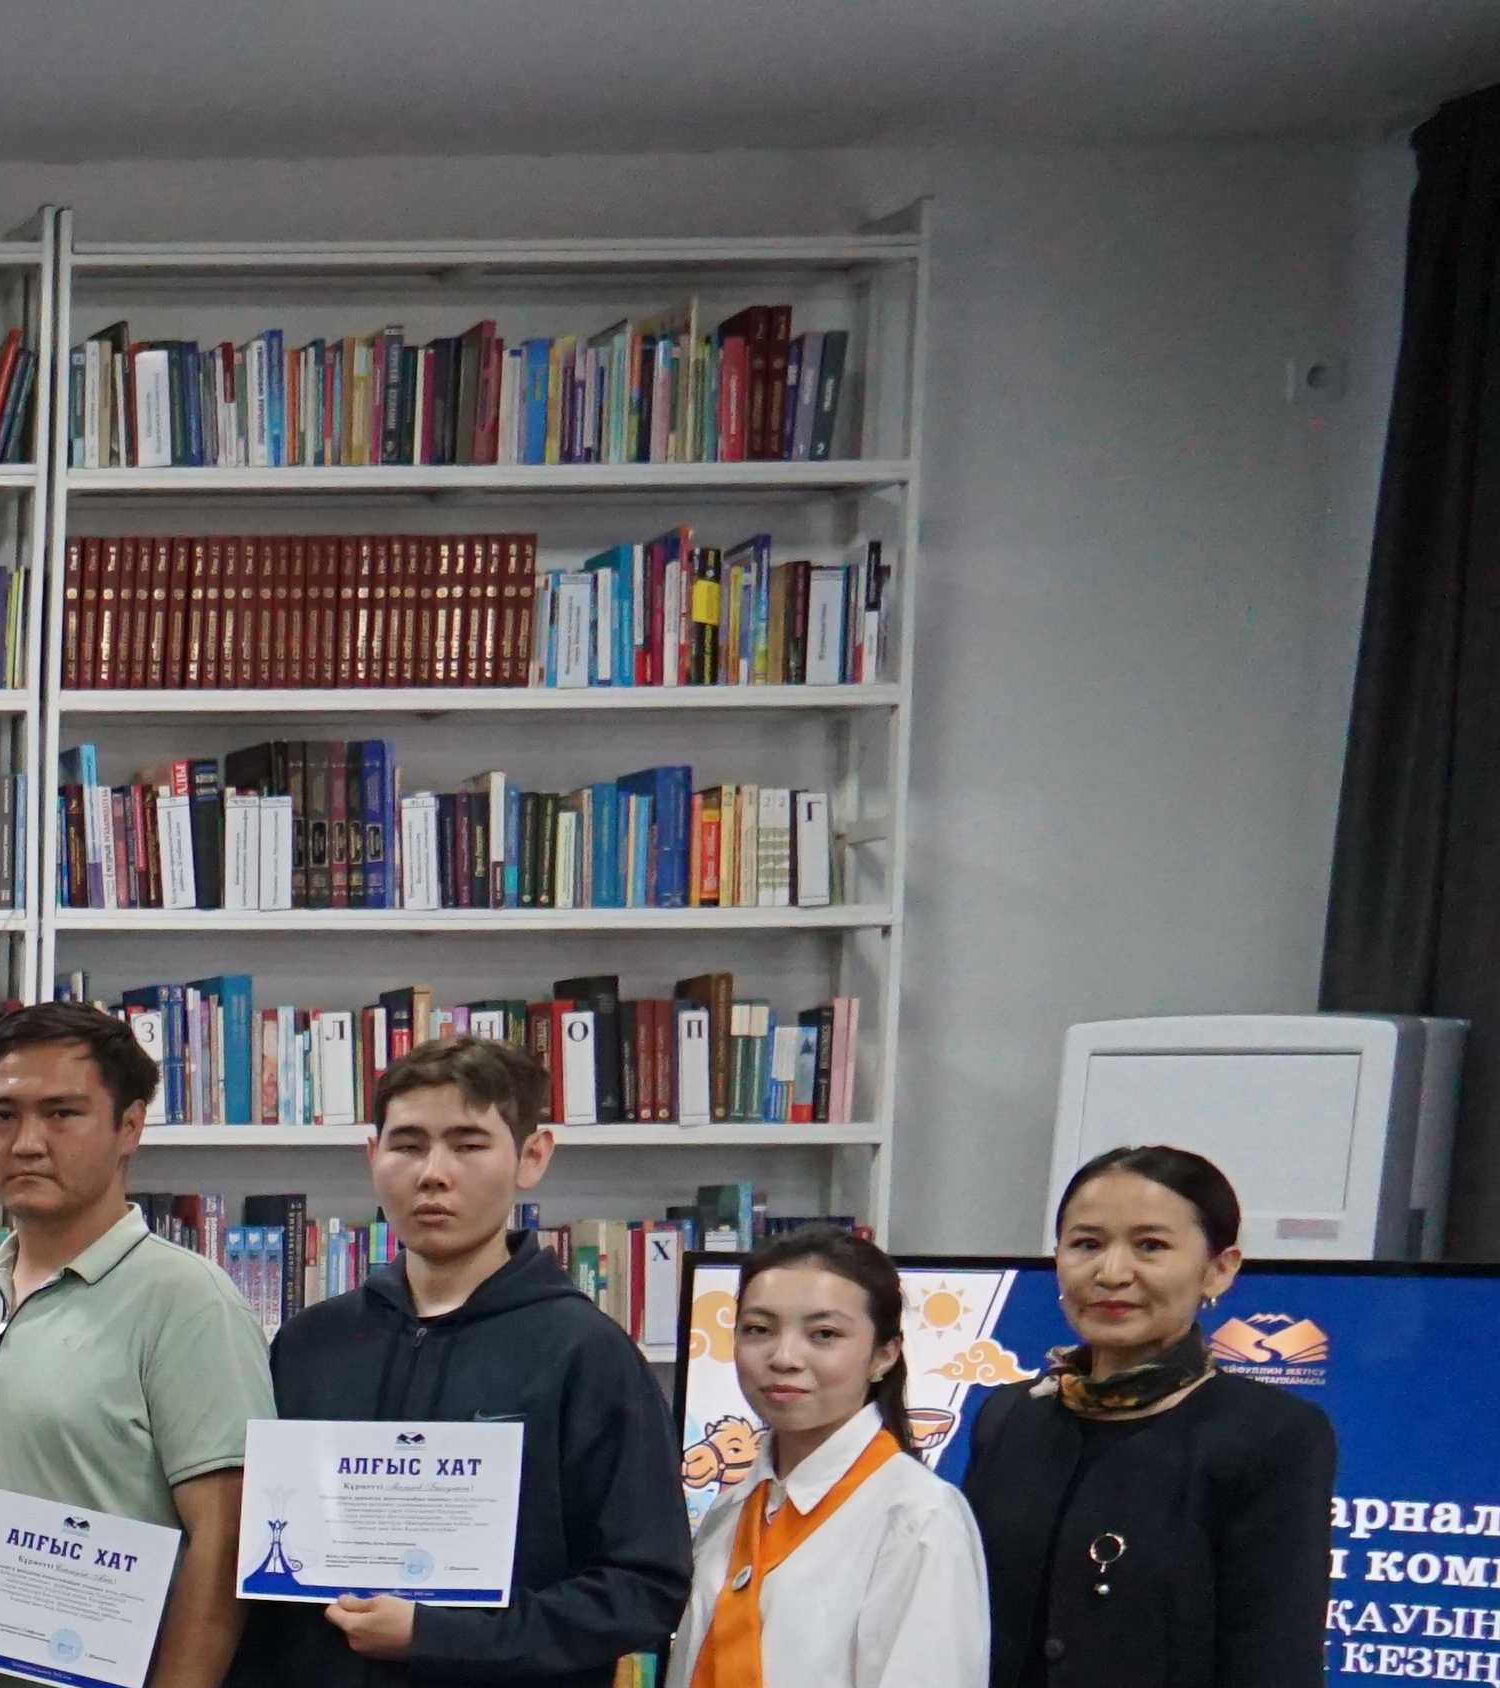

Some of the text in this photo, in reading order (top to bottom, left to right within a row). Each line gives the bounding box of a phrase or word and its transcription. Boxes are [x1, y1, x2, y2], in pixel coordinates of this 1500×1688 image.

[325, 1019, 347, 1041] Л
[567, 1020, 589, 1042] О
[685, 1019, 704, 1039] П
[651, 1240, 671, 1262] Х
[338, 1457, 483, 1476] АЛҒЫС ХАТ
[5, 1528, 138, 1573] АЛҒЫС ХАТ
[1365, 1551, 1500, 1589] ком
